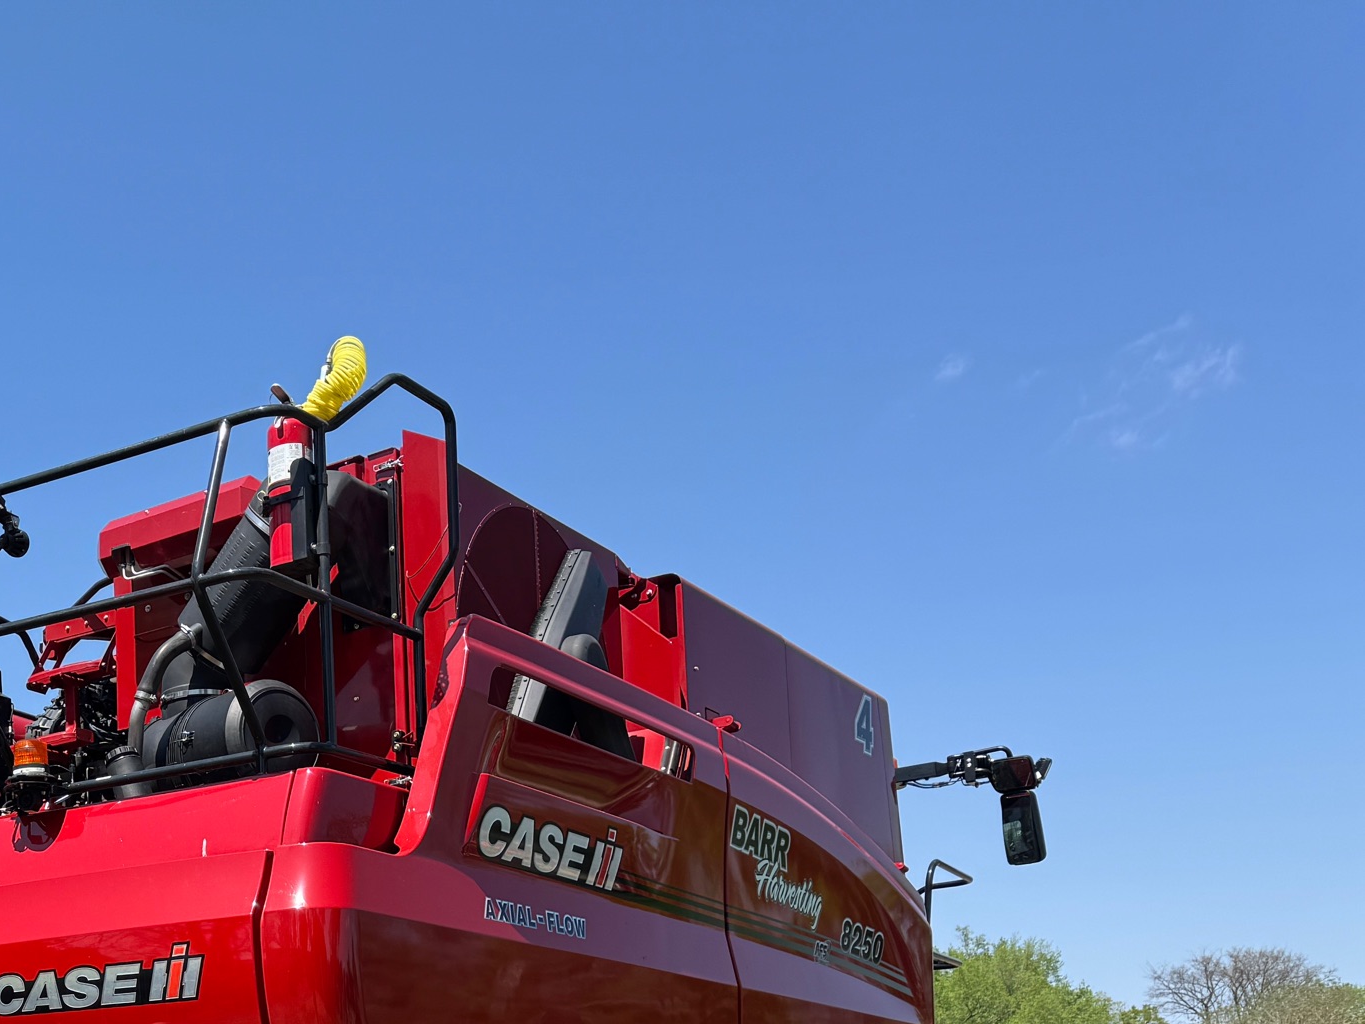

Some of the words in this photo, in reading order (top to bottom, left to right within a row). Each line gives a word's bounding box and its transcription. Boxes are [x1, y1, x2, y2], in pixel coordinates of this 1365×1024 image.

[855, 694, 874, 755] 4
[479, 806, 590, 881] CASE
[730, 804, 791, 872] BARR
[755, 858, 823, 931] Harvesting
[840, 917, 884, 965] 8250
